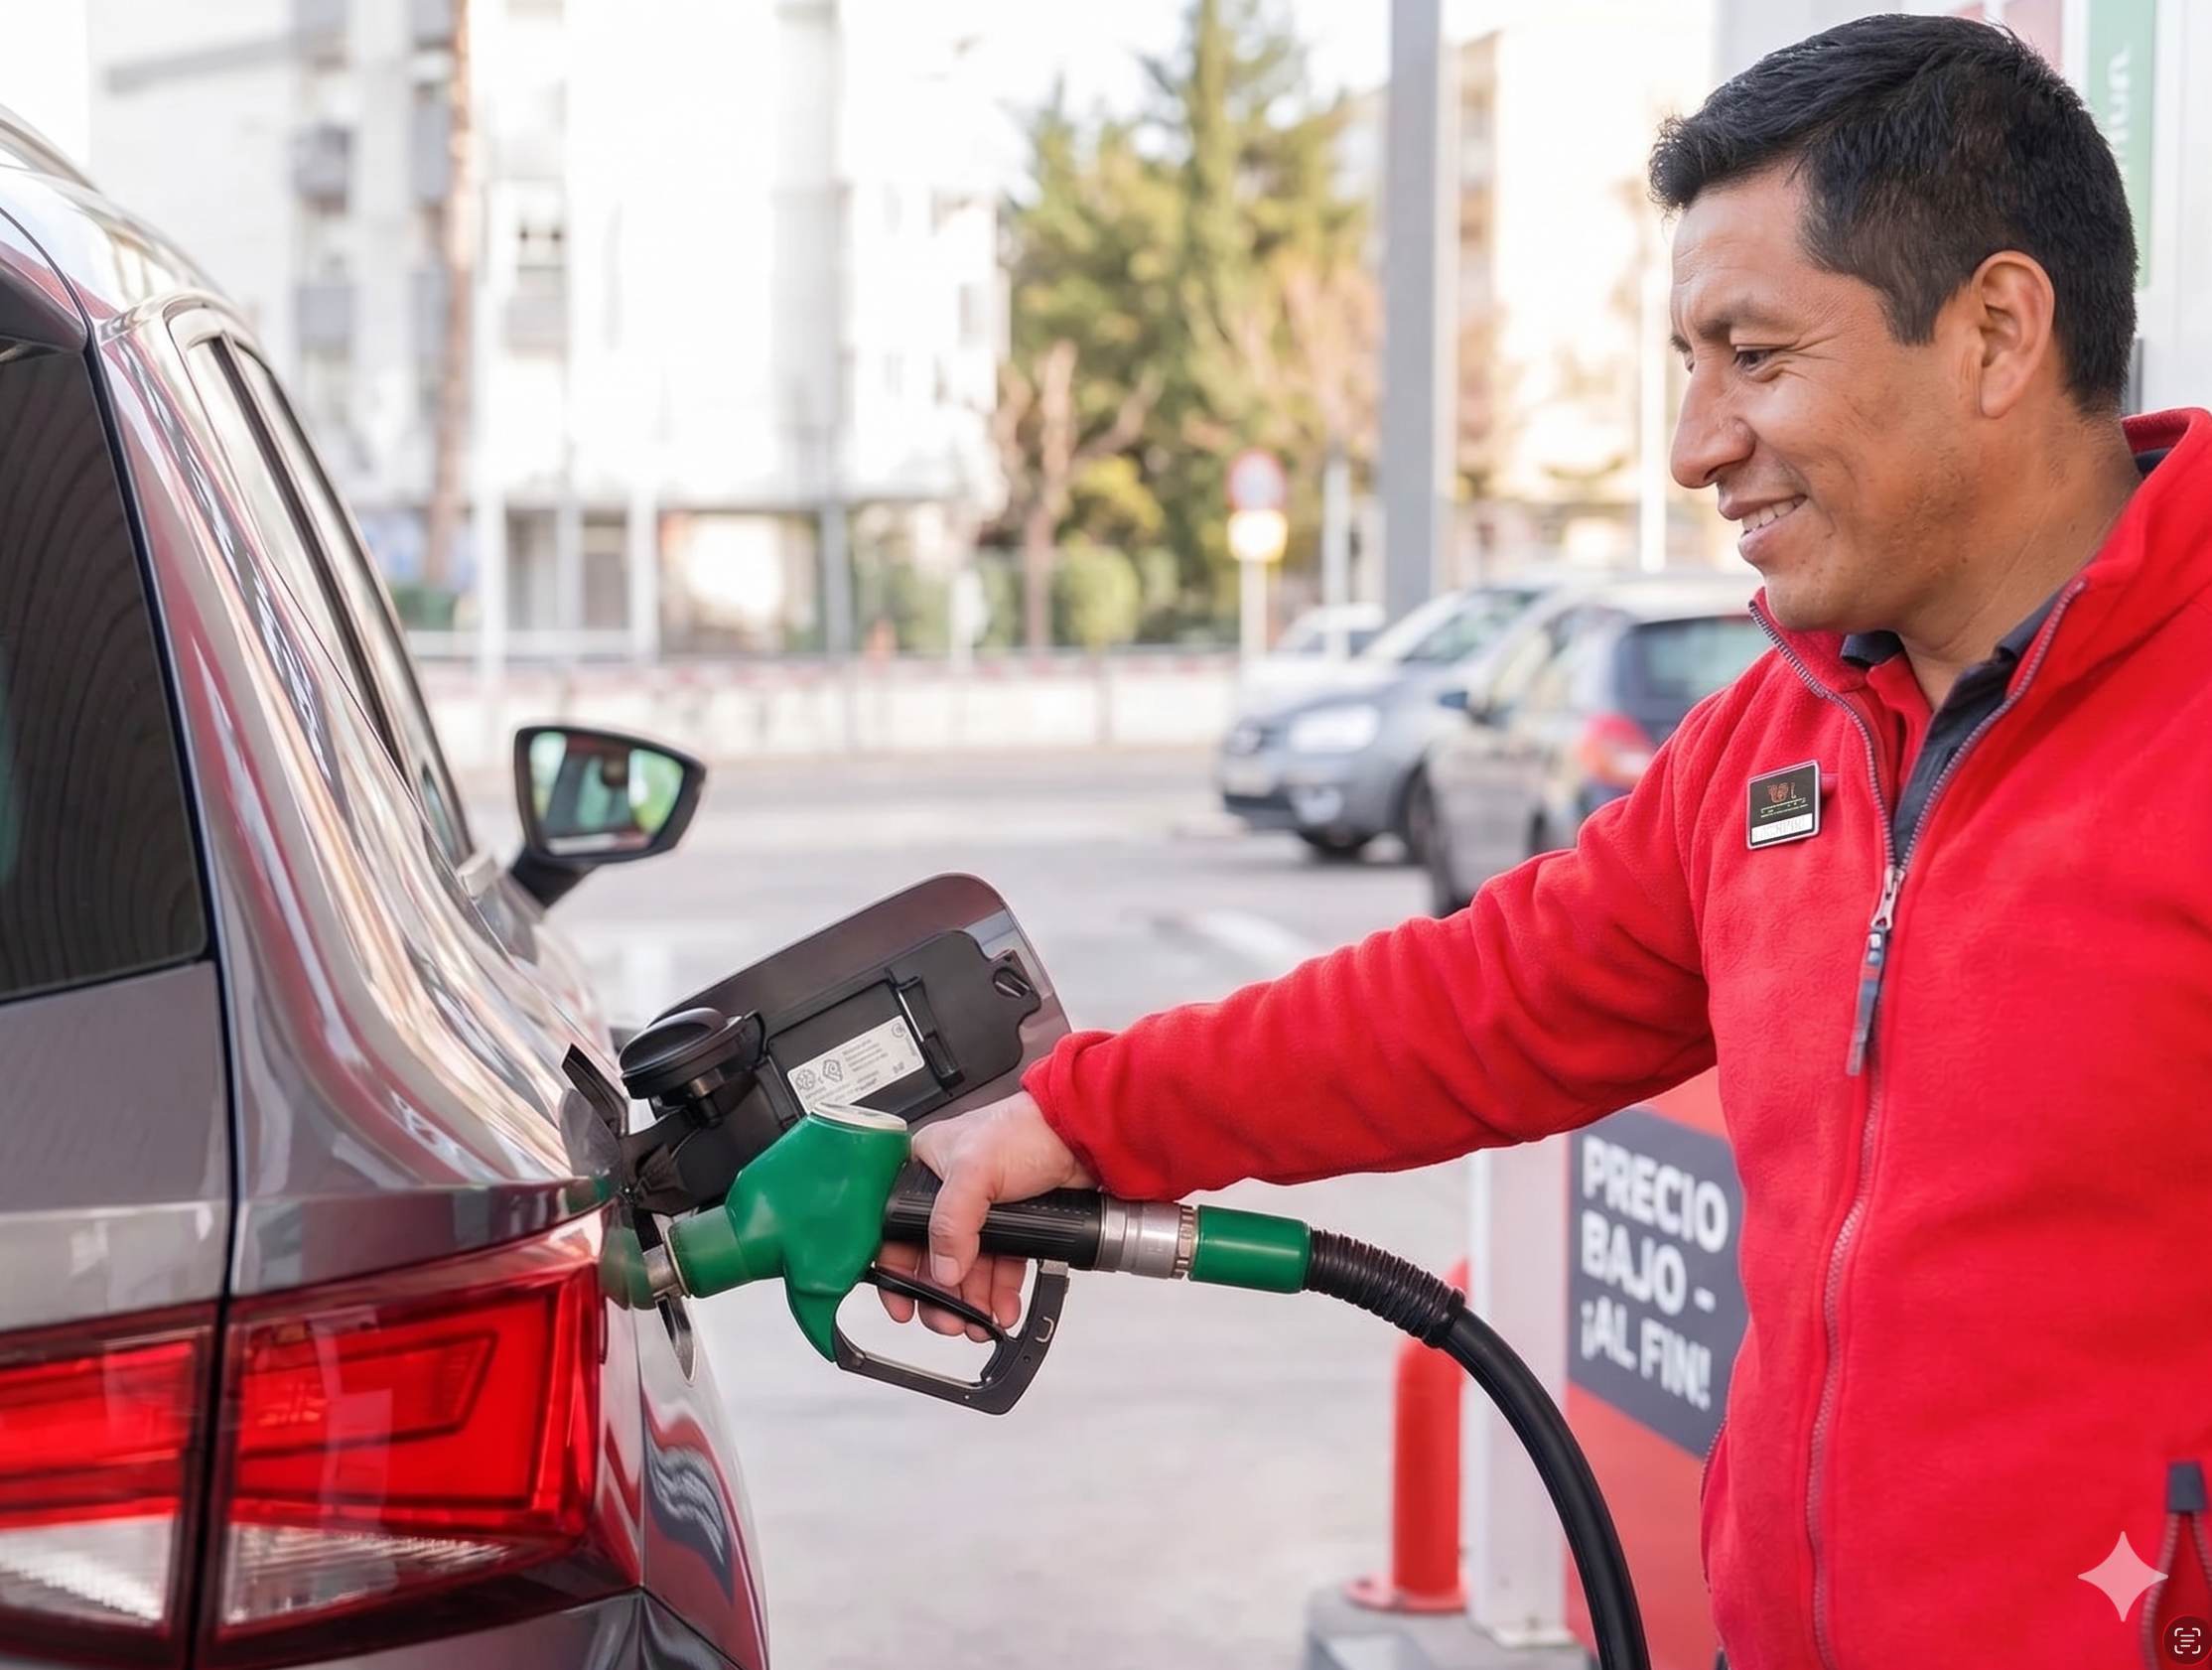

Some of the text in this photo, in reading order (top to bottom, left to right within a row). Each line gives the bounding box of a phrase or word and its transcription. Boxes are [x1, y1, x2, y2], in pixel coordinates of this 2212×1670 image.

[1583, 1134, 1728, 1253] PRECIO
[1582, 1209, 1687, 1316] BAJO
[1581, 1295, 1712, 1411] ¡AL FIN!
